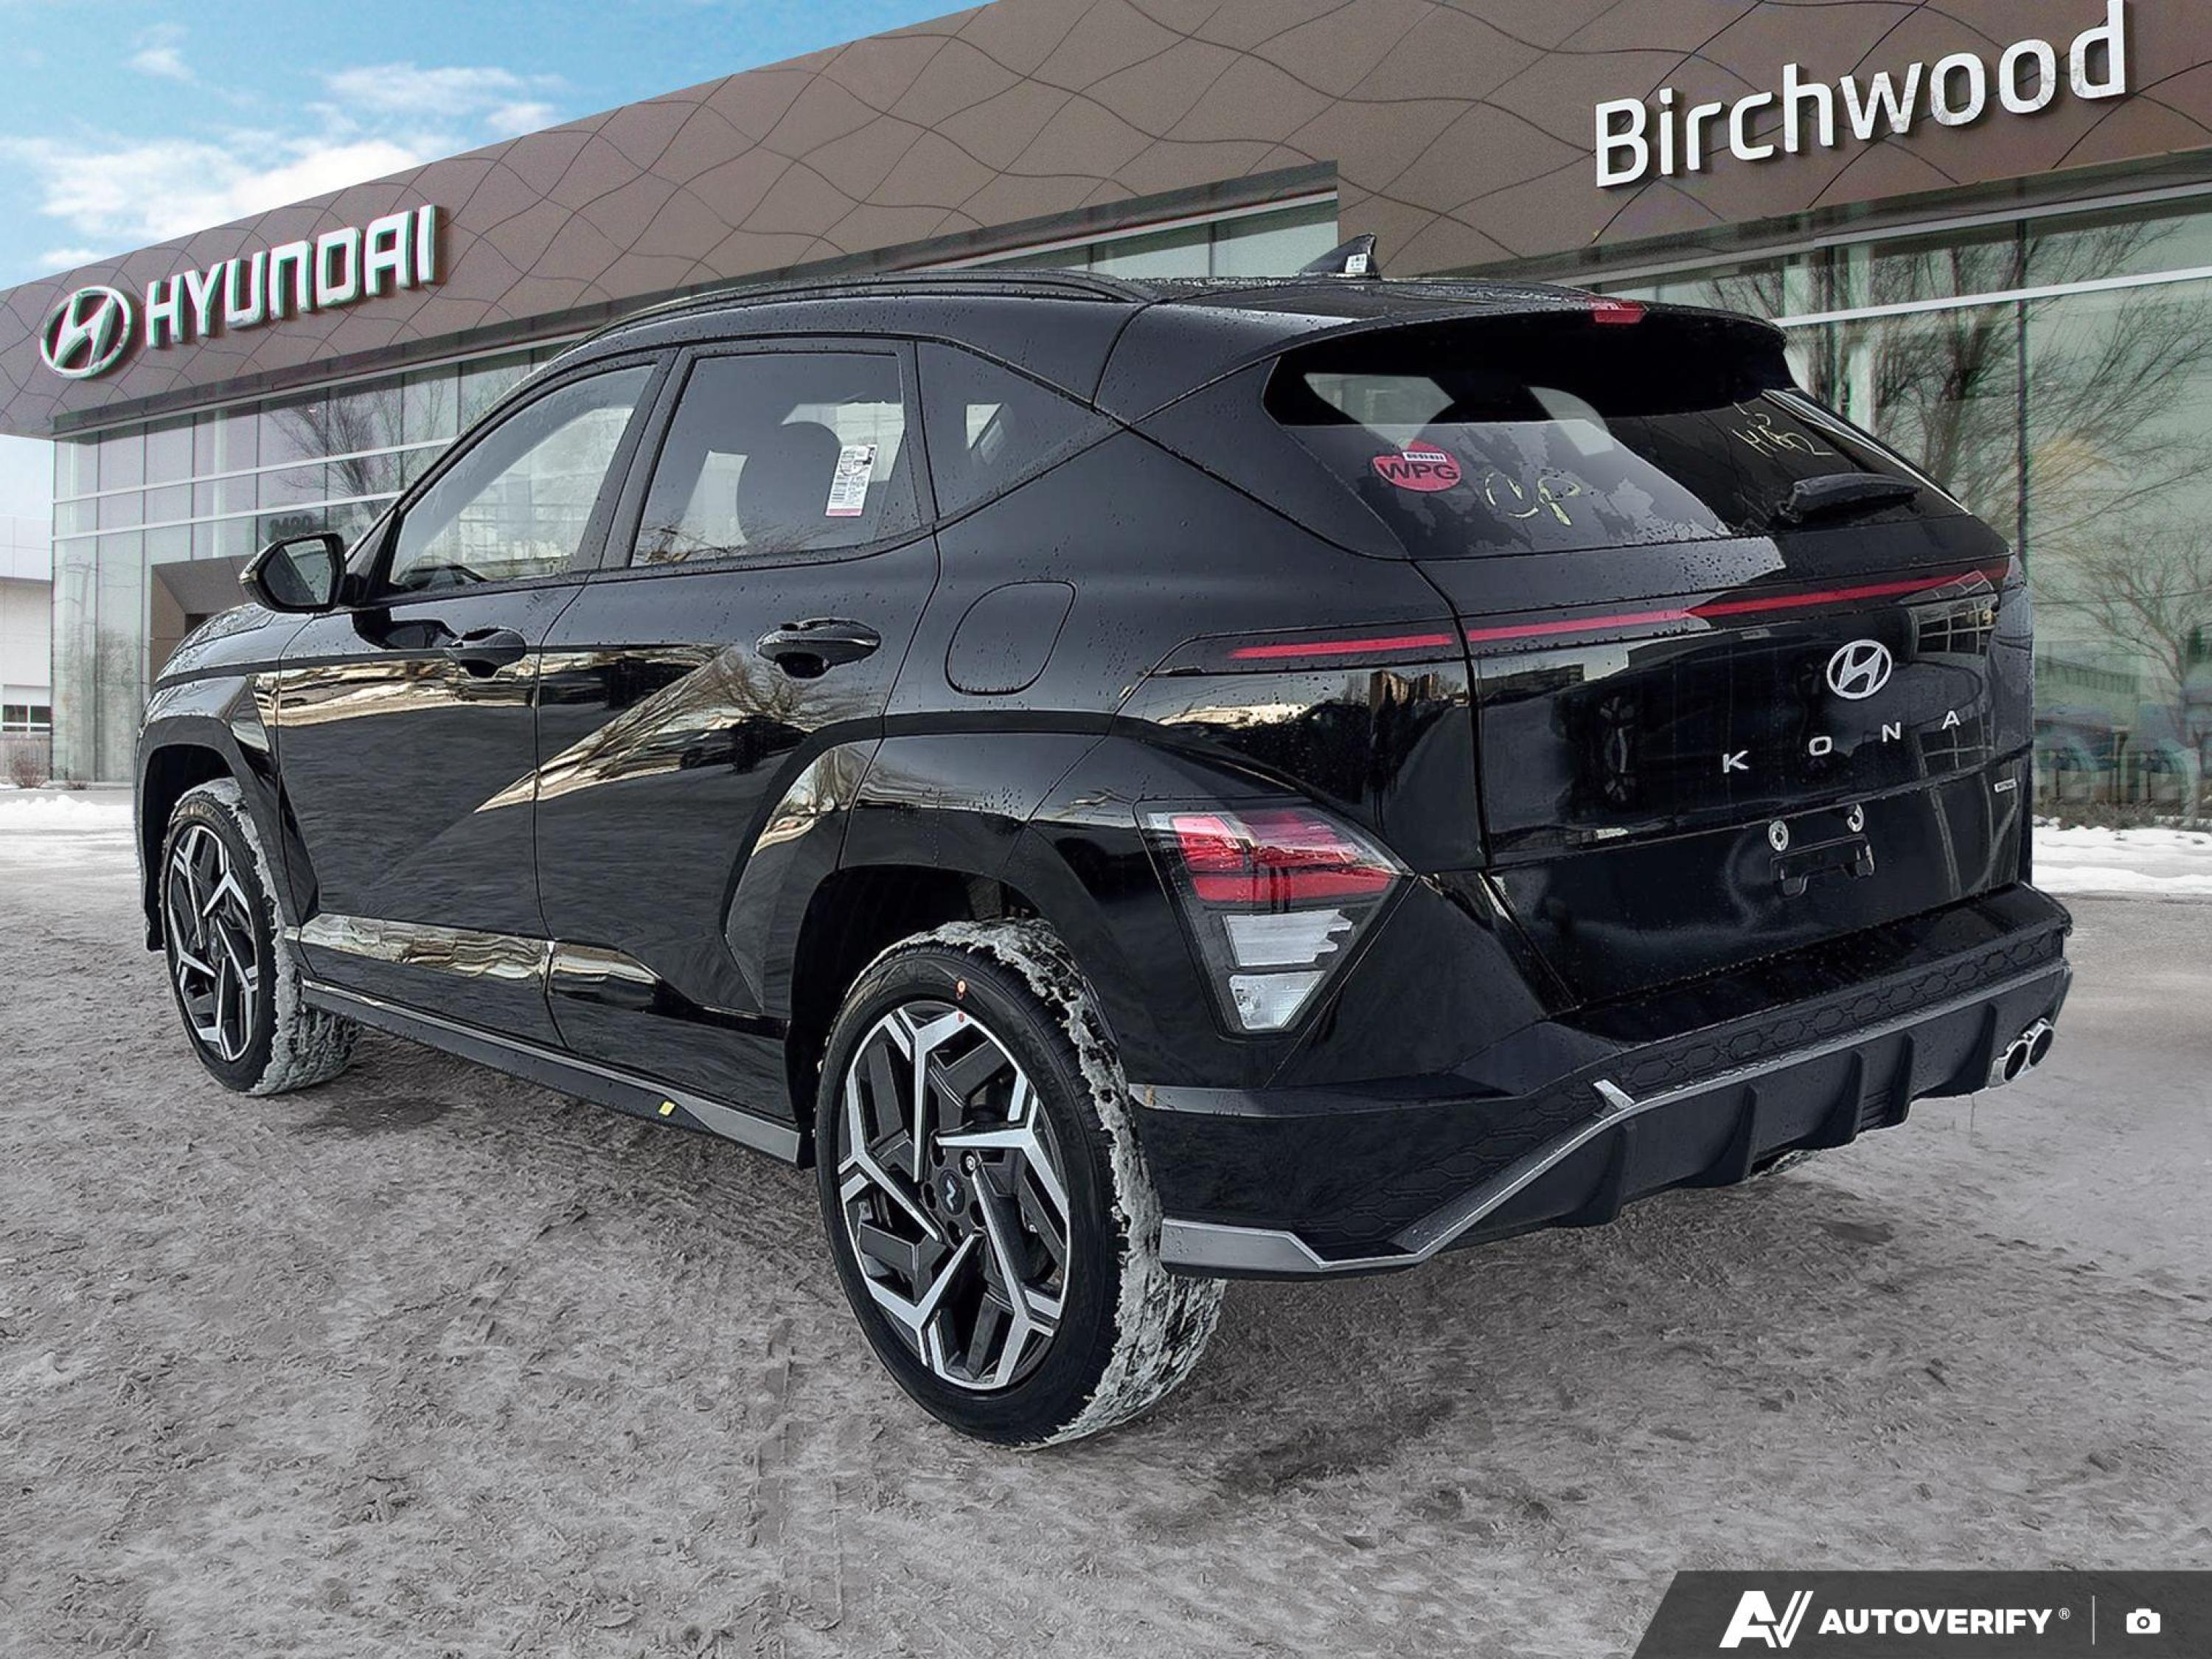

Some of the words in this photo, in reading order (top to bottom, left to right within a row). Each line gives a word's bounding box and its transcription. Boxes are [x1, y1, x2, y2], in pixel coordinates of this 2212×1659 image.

[1596, 0, 2126, 189] Birchwood
[145, 204, 438, 349] HYUNDAI
[1377, 462, 1458, 480] WPG
[1722, 710, 1961, 773] KONA
